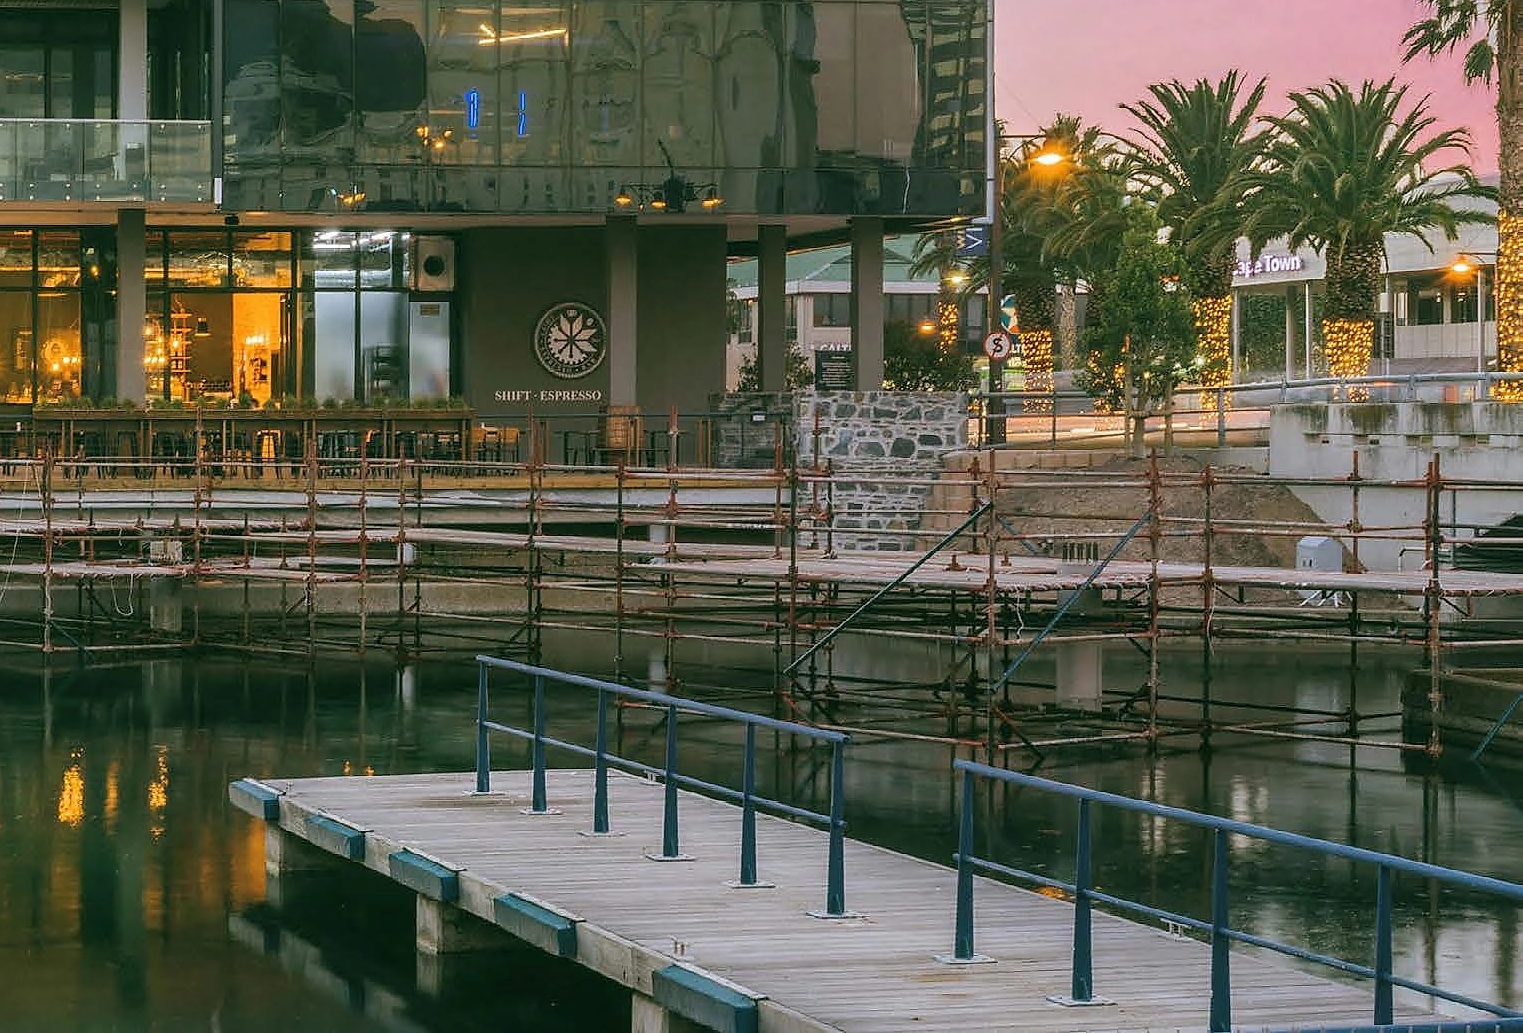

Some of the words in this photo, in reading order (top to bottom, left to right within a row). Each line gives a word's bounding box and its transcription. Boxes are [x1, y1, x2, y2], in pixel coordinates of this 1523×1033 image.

[1264, 254, 1301, 272] Town
[494, 390, 531, 401] SHIFT
[540, 390, 602, 401] ESPRESSO
